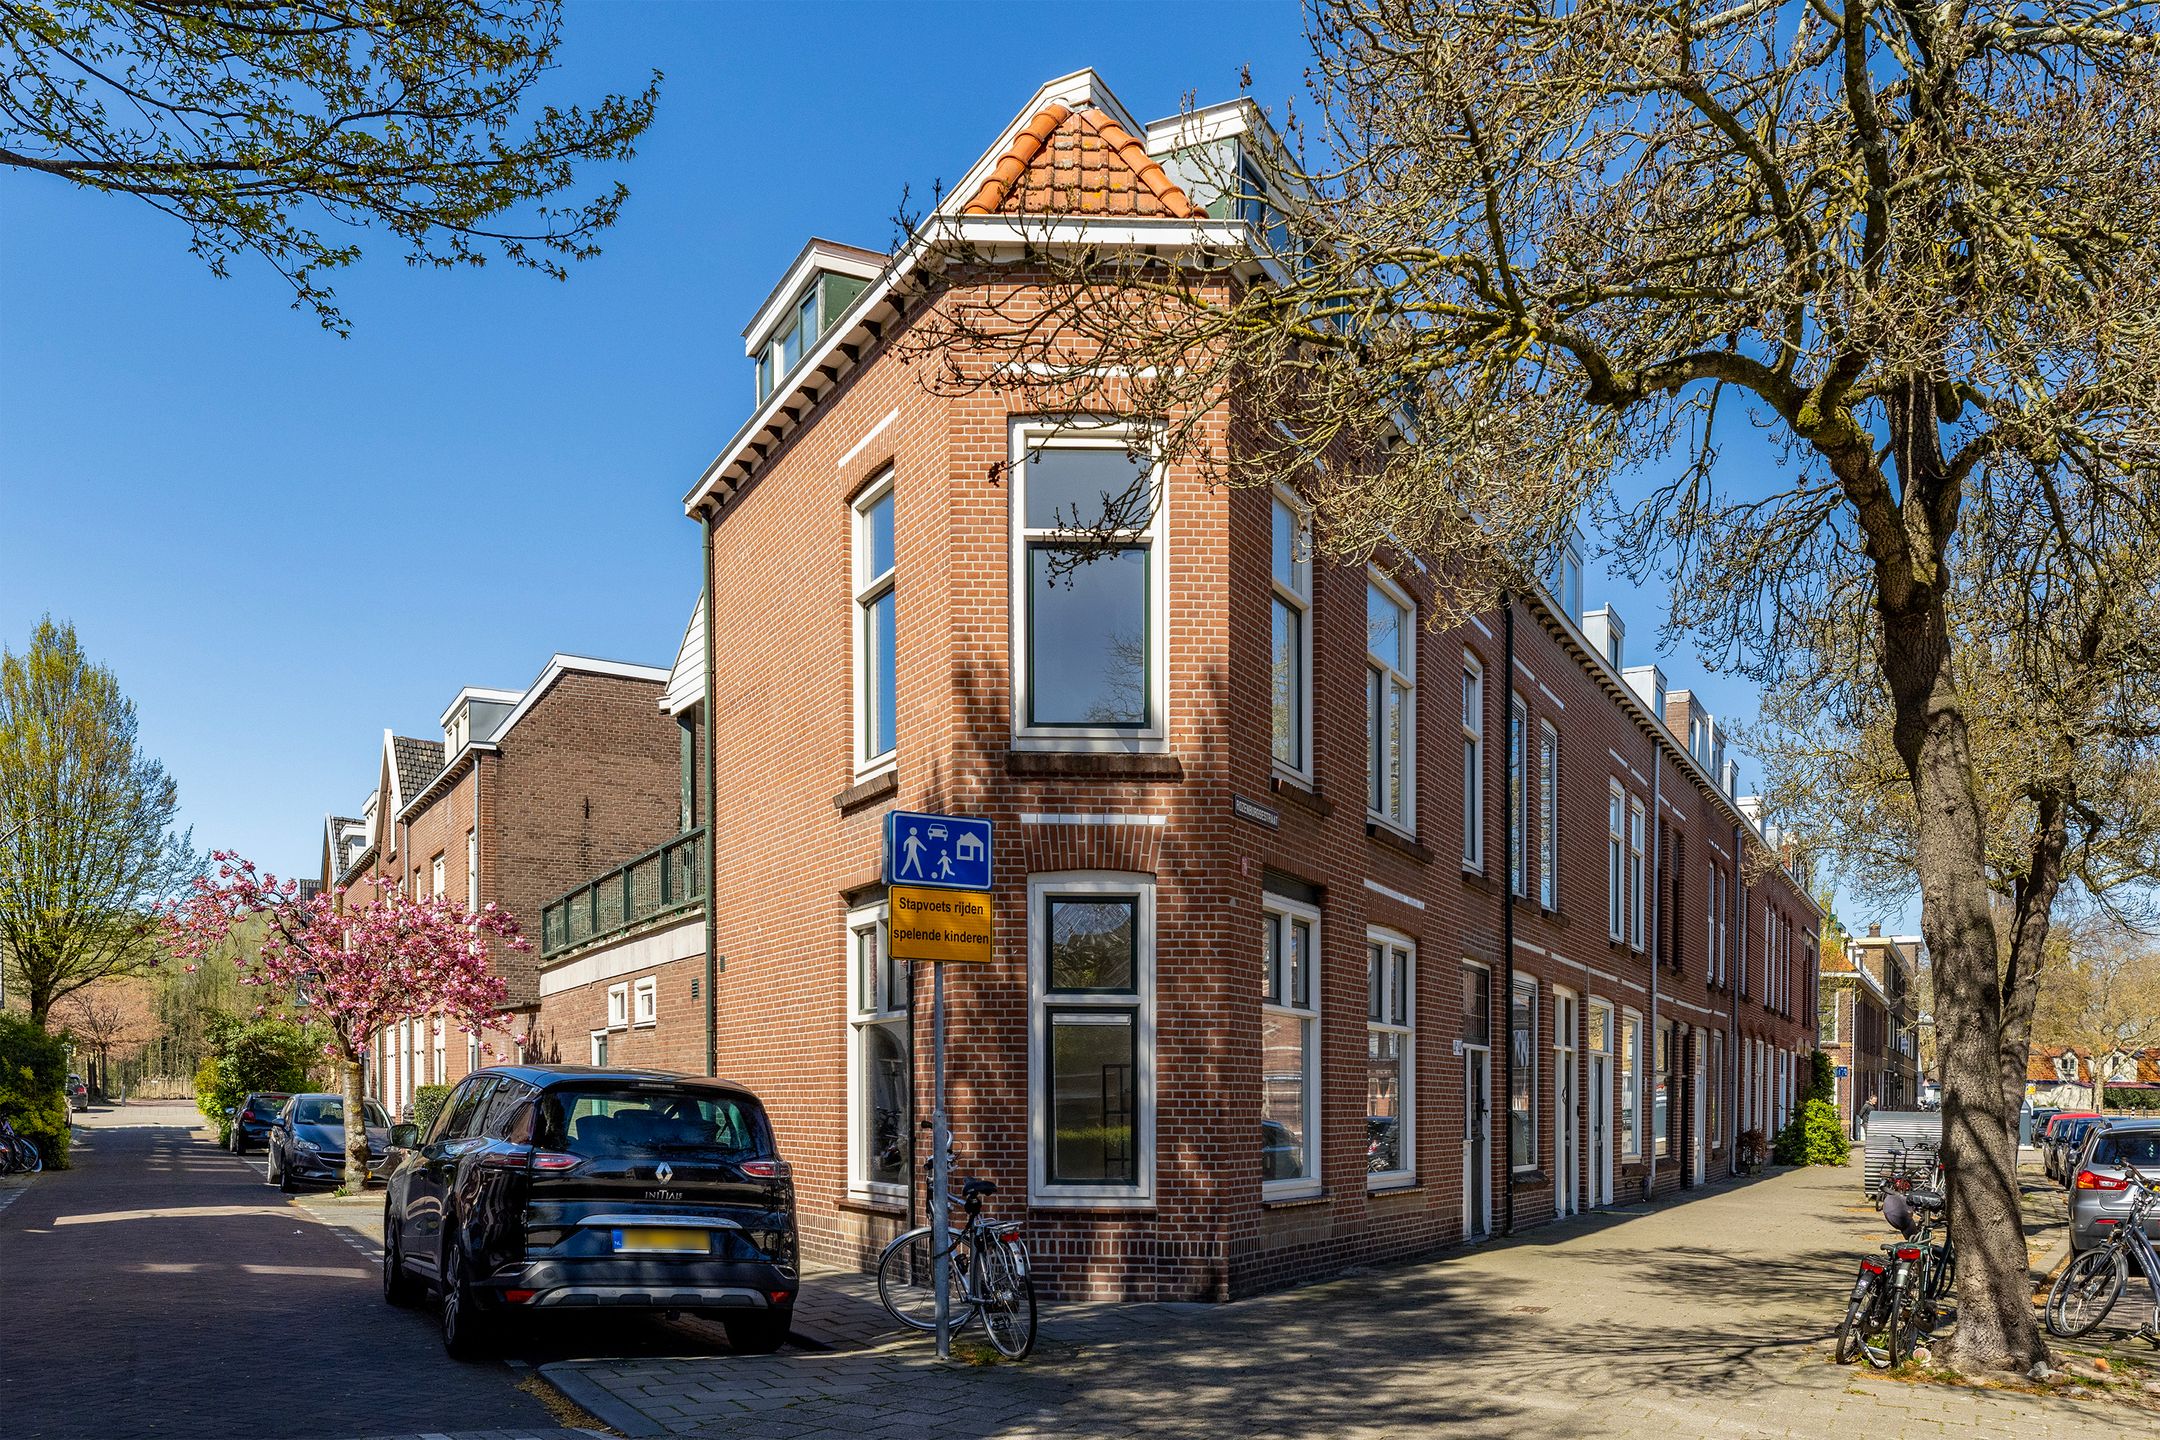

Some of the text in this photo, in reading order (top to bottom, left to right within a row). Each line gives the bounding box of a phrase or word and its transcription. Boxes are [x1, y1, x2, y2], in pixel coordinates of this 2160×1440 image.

[899, 897, 984, 916] Stapvoets rijden
[893, 928, 989, 944] spelende kinderen
[645, 1190, 683, 1200] INITIALE
